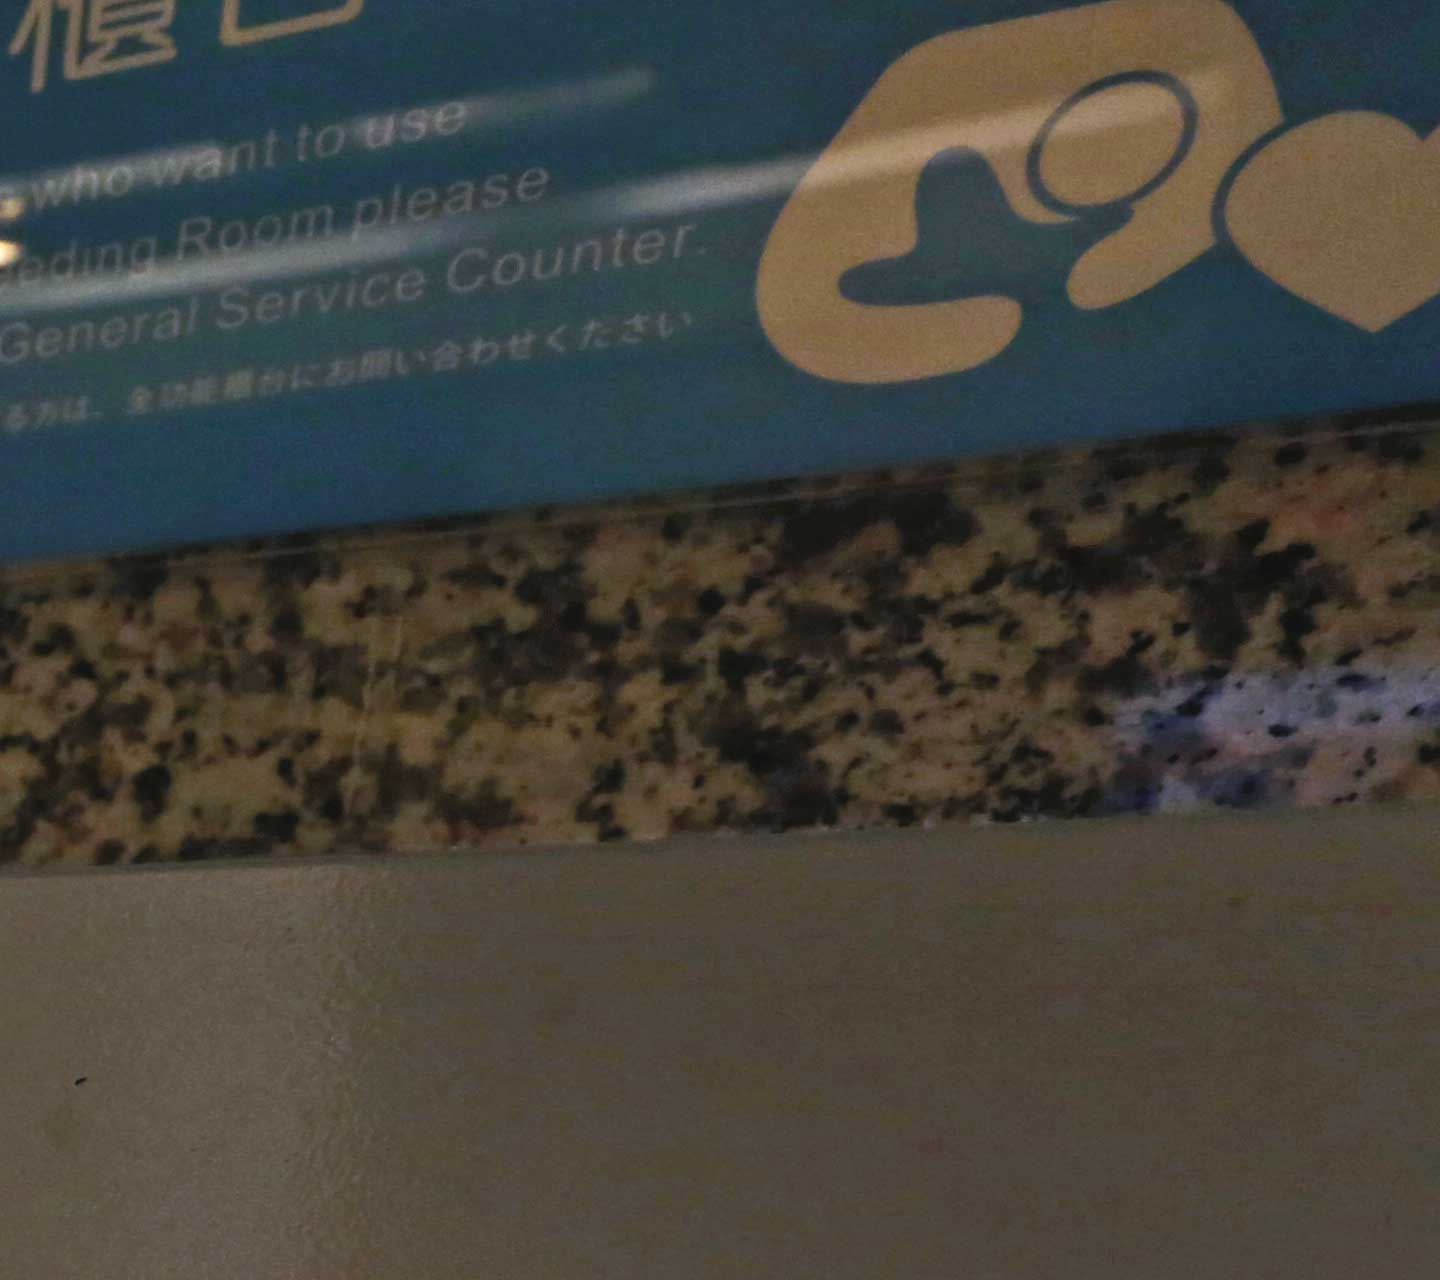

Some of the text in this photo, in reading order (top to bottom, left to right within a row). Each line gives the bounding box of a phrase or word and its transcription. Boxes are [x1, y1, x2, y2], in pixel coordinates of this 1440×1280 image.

[32, 162, 136, 210] who
[154, 130, 280, 187] want
[295, 121, 347, 163] to
[363, 100, 467, 149] use
[177, 205, 335, 261] Room
[351, 166, 550, 241] please
[216, 265, 426, 328] Service
